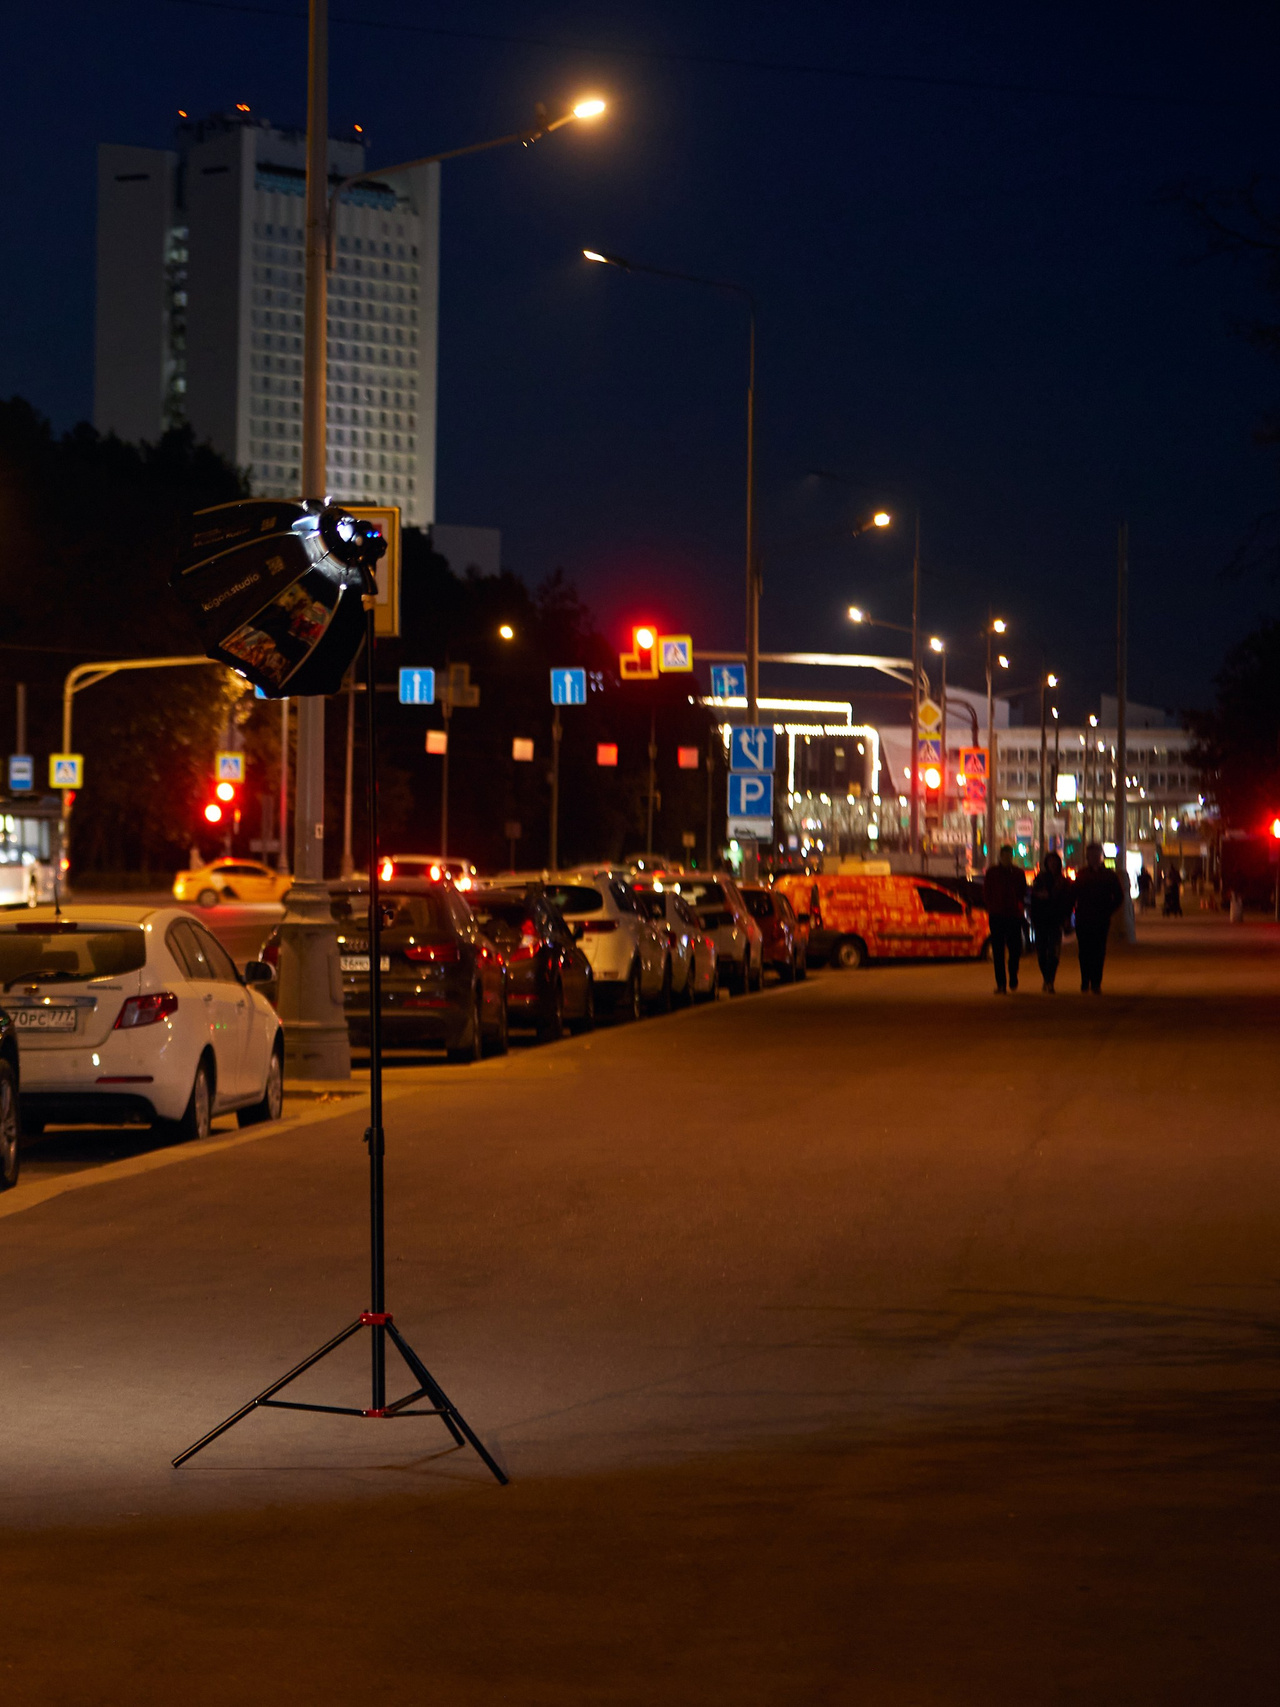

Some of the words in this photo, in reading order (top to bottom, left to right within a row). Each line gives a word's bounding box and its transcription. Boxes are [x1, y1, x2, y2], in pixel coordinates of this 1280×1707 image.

[201, 573, 260, 612] kogan.studio
[740, 777, 765, 813] P
[11, 1011, 47, 1026] 70РС
